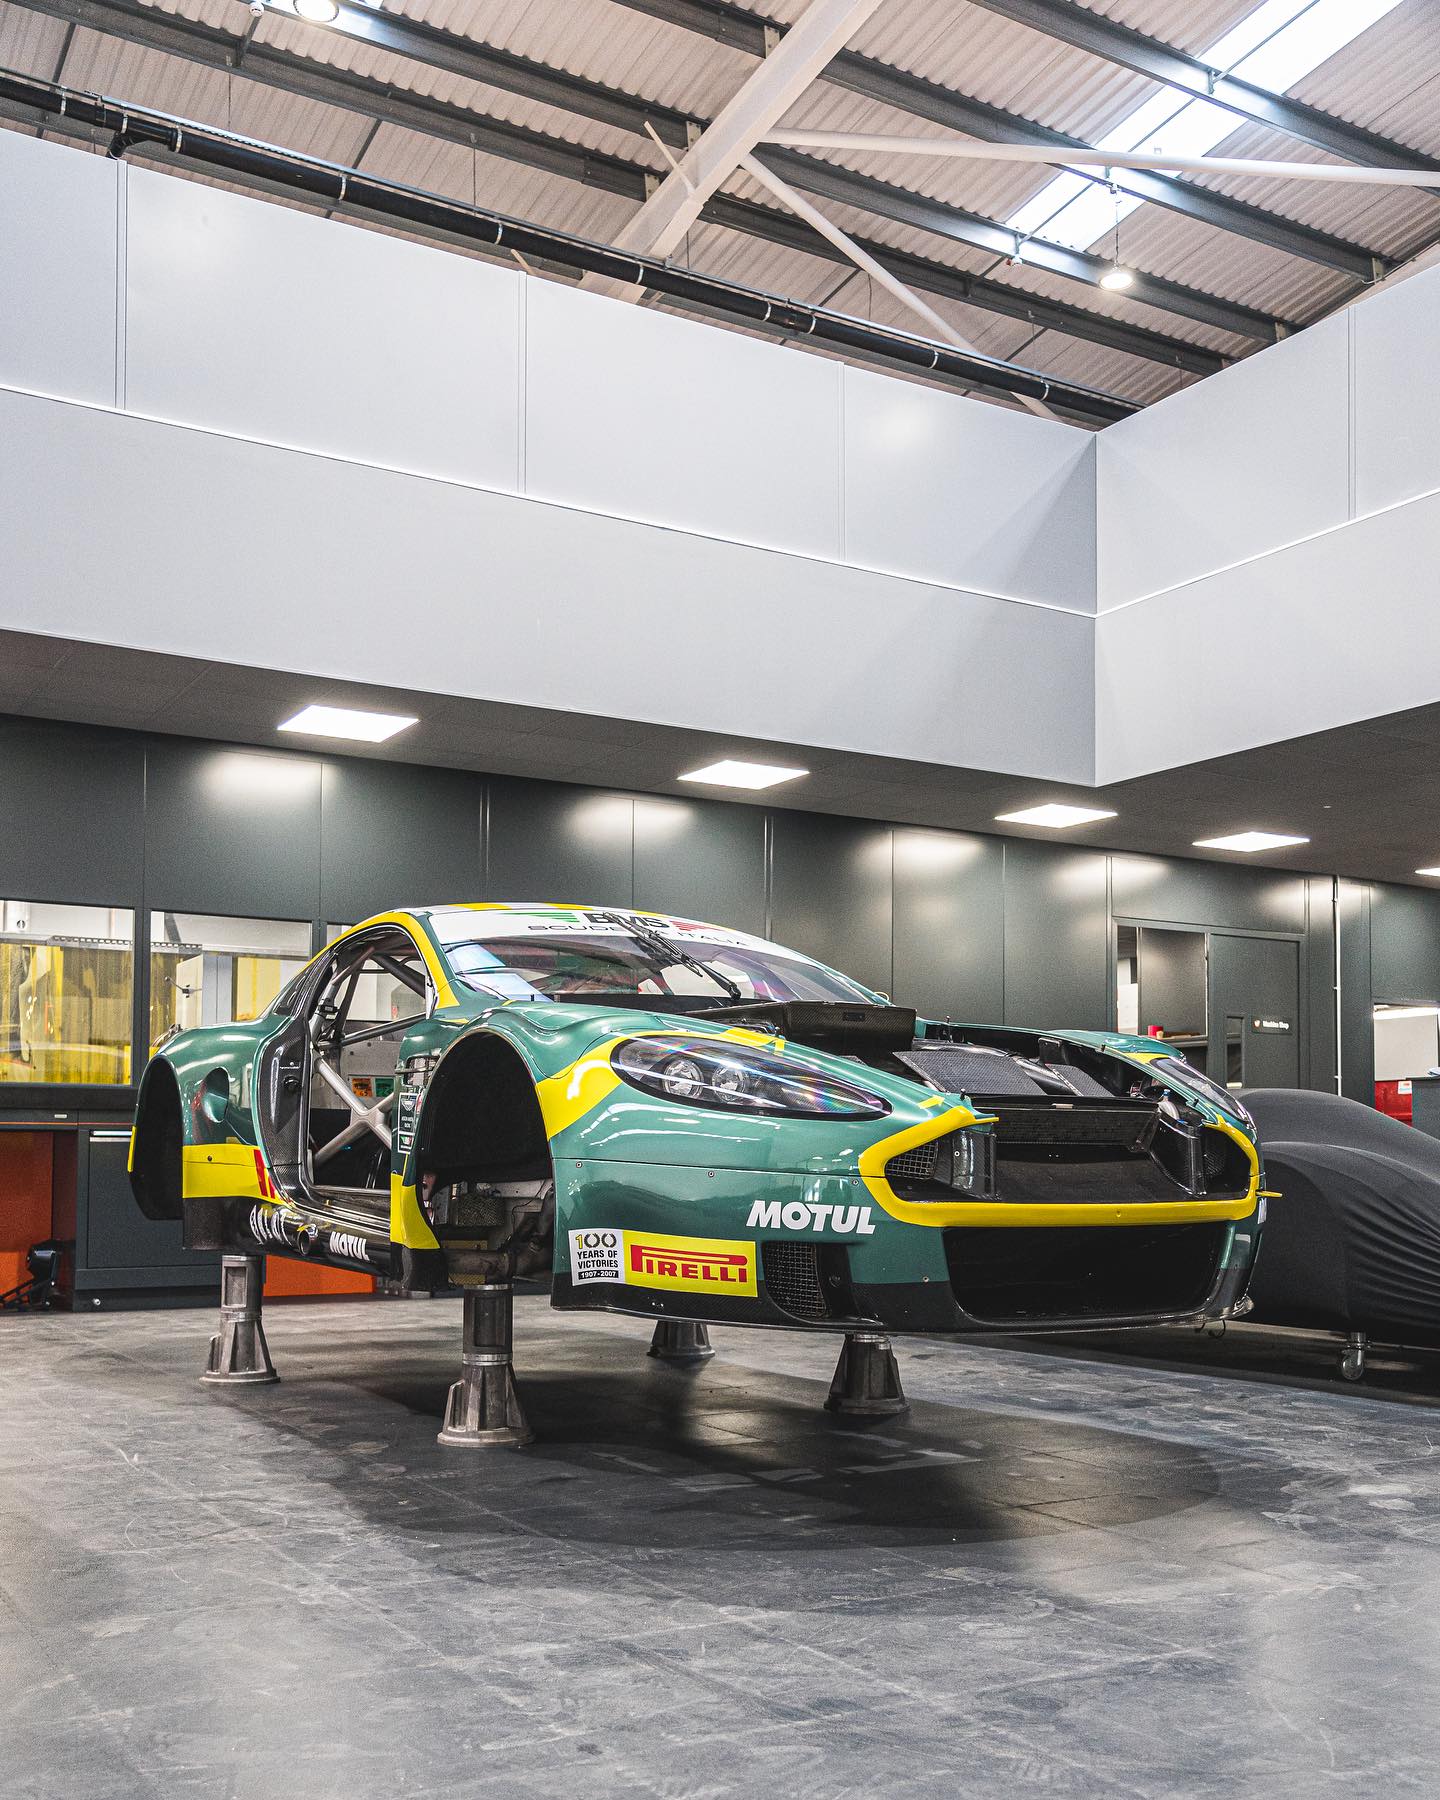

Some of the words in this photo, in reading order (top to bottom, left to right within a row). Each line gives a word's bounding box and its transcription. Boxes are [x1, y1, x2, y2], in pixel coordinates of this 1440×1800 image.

[677, 931, 749, 947] ITALIA
[746, 1200, 876, 1235] MOTUL
[329, 1231, 370, 1261] MOTUL
[575, 1232, 617, 1250] 100
[577, 1250, 605, 1260] YEARS
[607, 1250, 618, 1259] OF
[577, 1259, 619, 1270] VICTORIES
[630, 1244, 748, 1284] PIRELLI
[580, 1270, 617, 1279] 1907-2007
